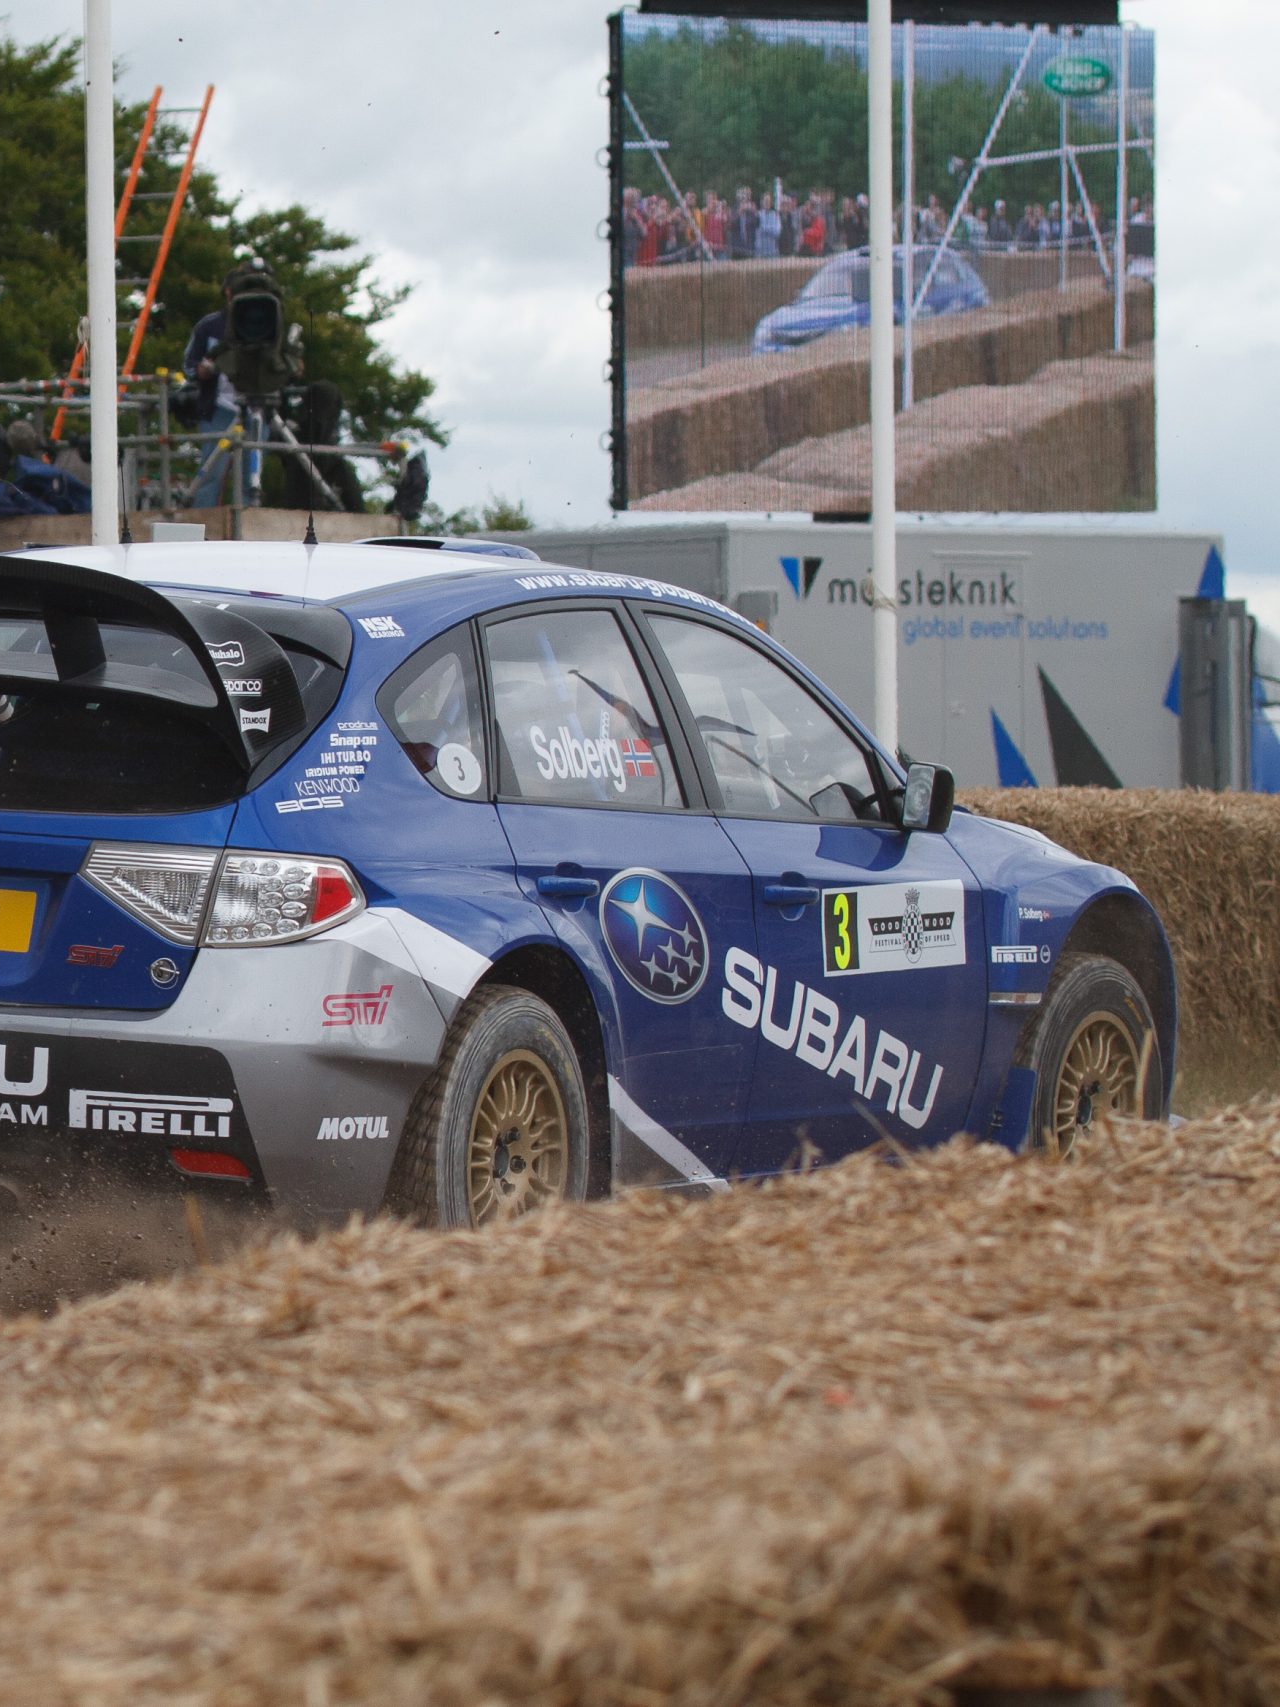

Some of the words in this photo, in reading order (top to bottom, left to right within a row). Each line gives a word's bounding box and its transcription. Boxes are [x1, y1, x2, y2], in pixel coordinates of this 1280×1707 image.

[827, 569, 1018, 605] msteknik
[357, 616, 401, 633] NSK
[368, 628, 405, 639] BEARINGS
[902, 617, 963, 645] global
[971, 619, 1020, 640] event
[1028, 617, 1109, 640] solutions
[223, 679, 261, 693] sparco
[242, 716, 268, 725] STANDOX
[330, 733, 377, 747] Snap-on
[320, 753, 336, 764] IHI
[337, 750, 371, 762] TURBO
[529, 725, 627, 793] Solberg
[305, 767, 338, 778] IRIDIUM
[338, 765, 365, 775] POWER
[453, 756, 466, 781] 3
[295, 777, 360, 797] KENWOOD
[834, 893, 851, 970] 3
[874, 936, 902, 947] FESTIVAL
[991, 945, 1038, 963] PIRELLI
[721, 946, 944, 1130] SUBARU
[68, 1089, 233, 1138] PIRELLI
[316, 1116, 390, 1141] MOTUL
